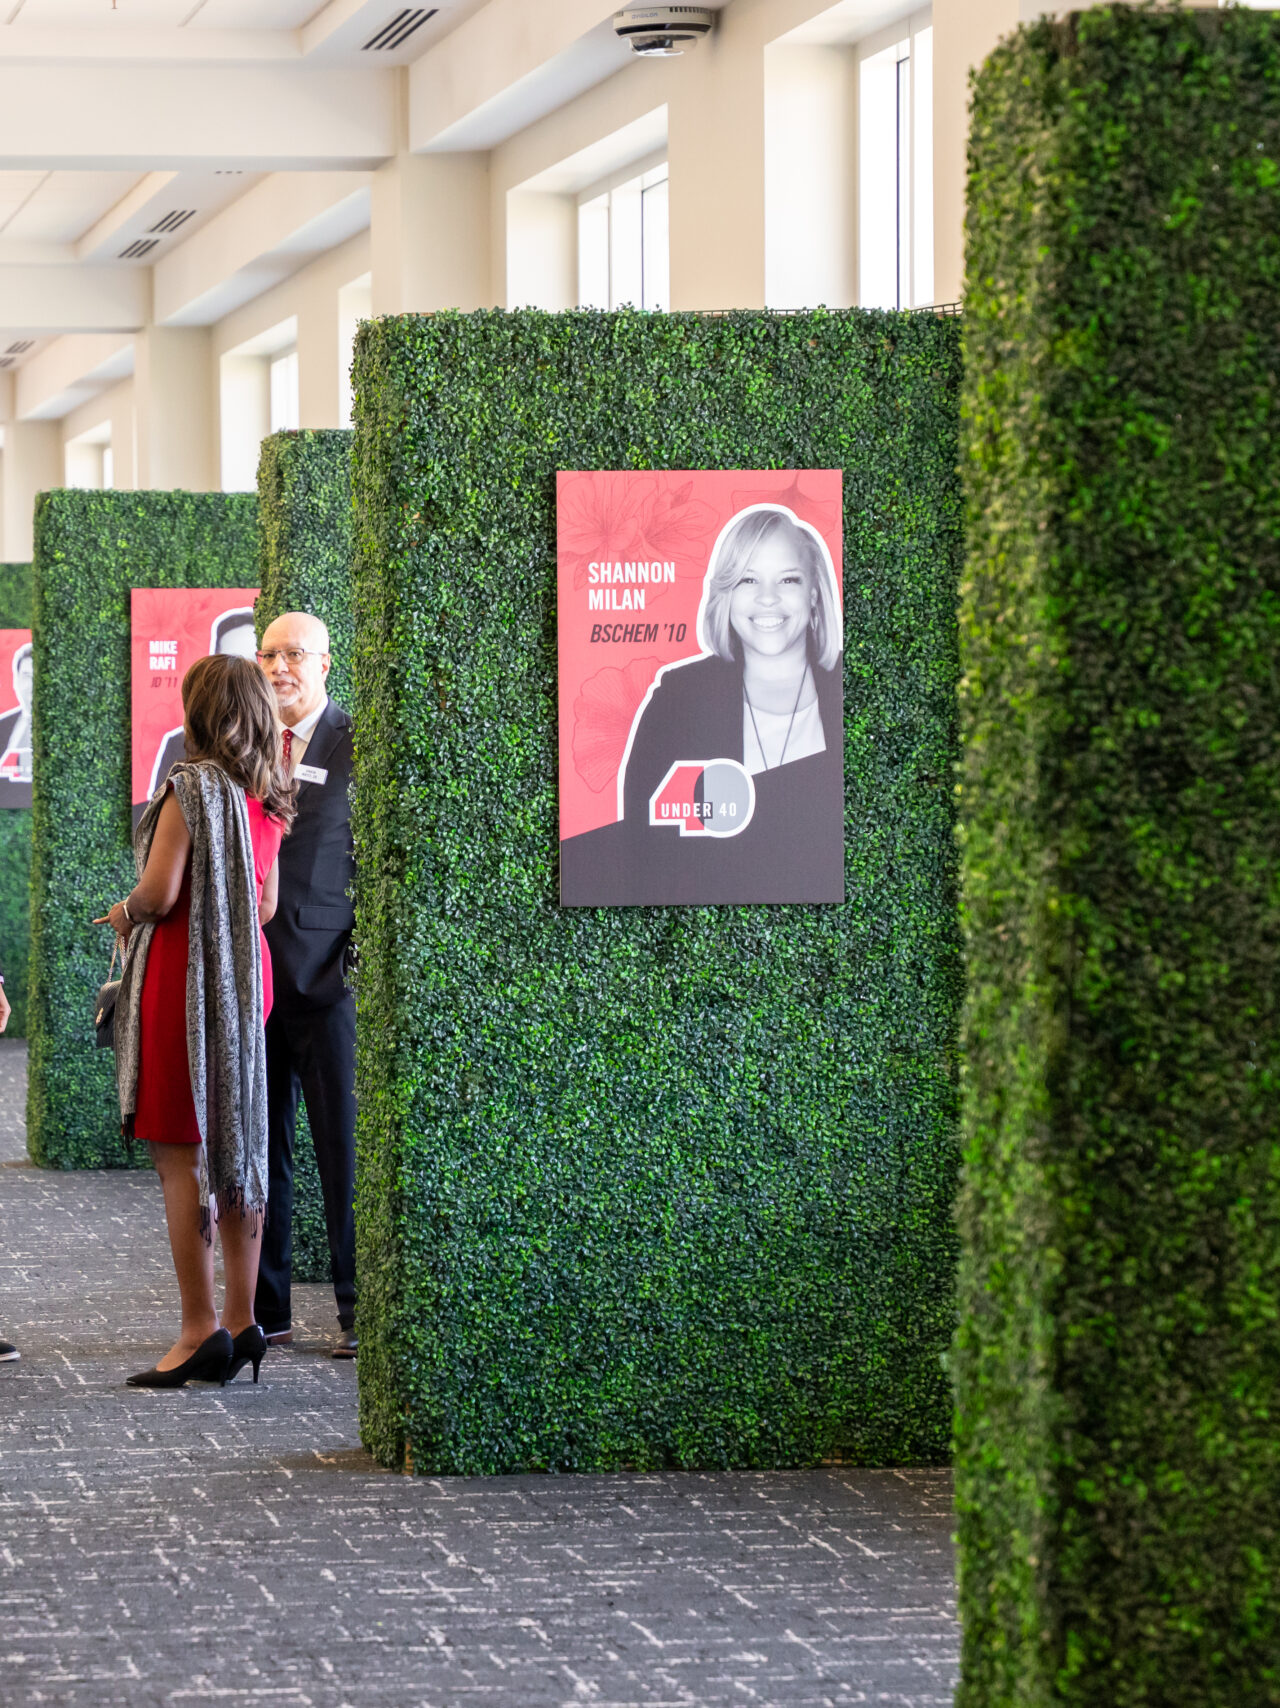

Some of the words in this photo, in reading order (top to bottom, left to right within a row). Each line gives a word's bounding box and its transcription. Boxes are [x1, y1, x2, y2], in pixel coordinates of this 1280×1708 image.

[588, 561, 676, 584] SHANNON
[588, 588, 646, 611] MILAN
[590, 623, 659, 643] BSCHEM
[663, 623, 687, 642] '10
[149, 640, 178, 655] MIKE
[149, 656, 176, 671] RAFI
[661, 802, 712, 818] UNDER
[719, 802, 737, 817] 40
